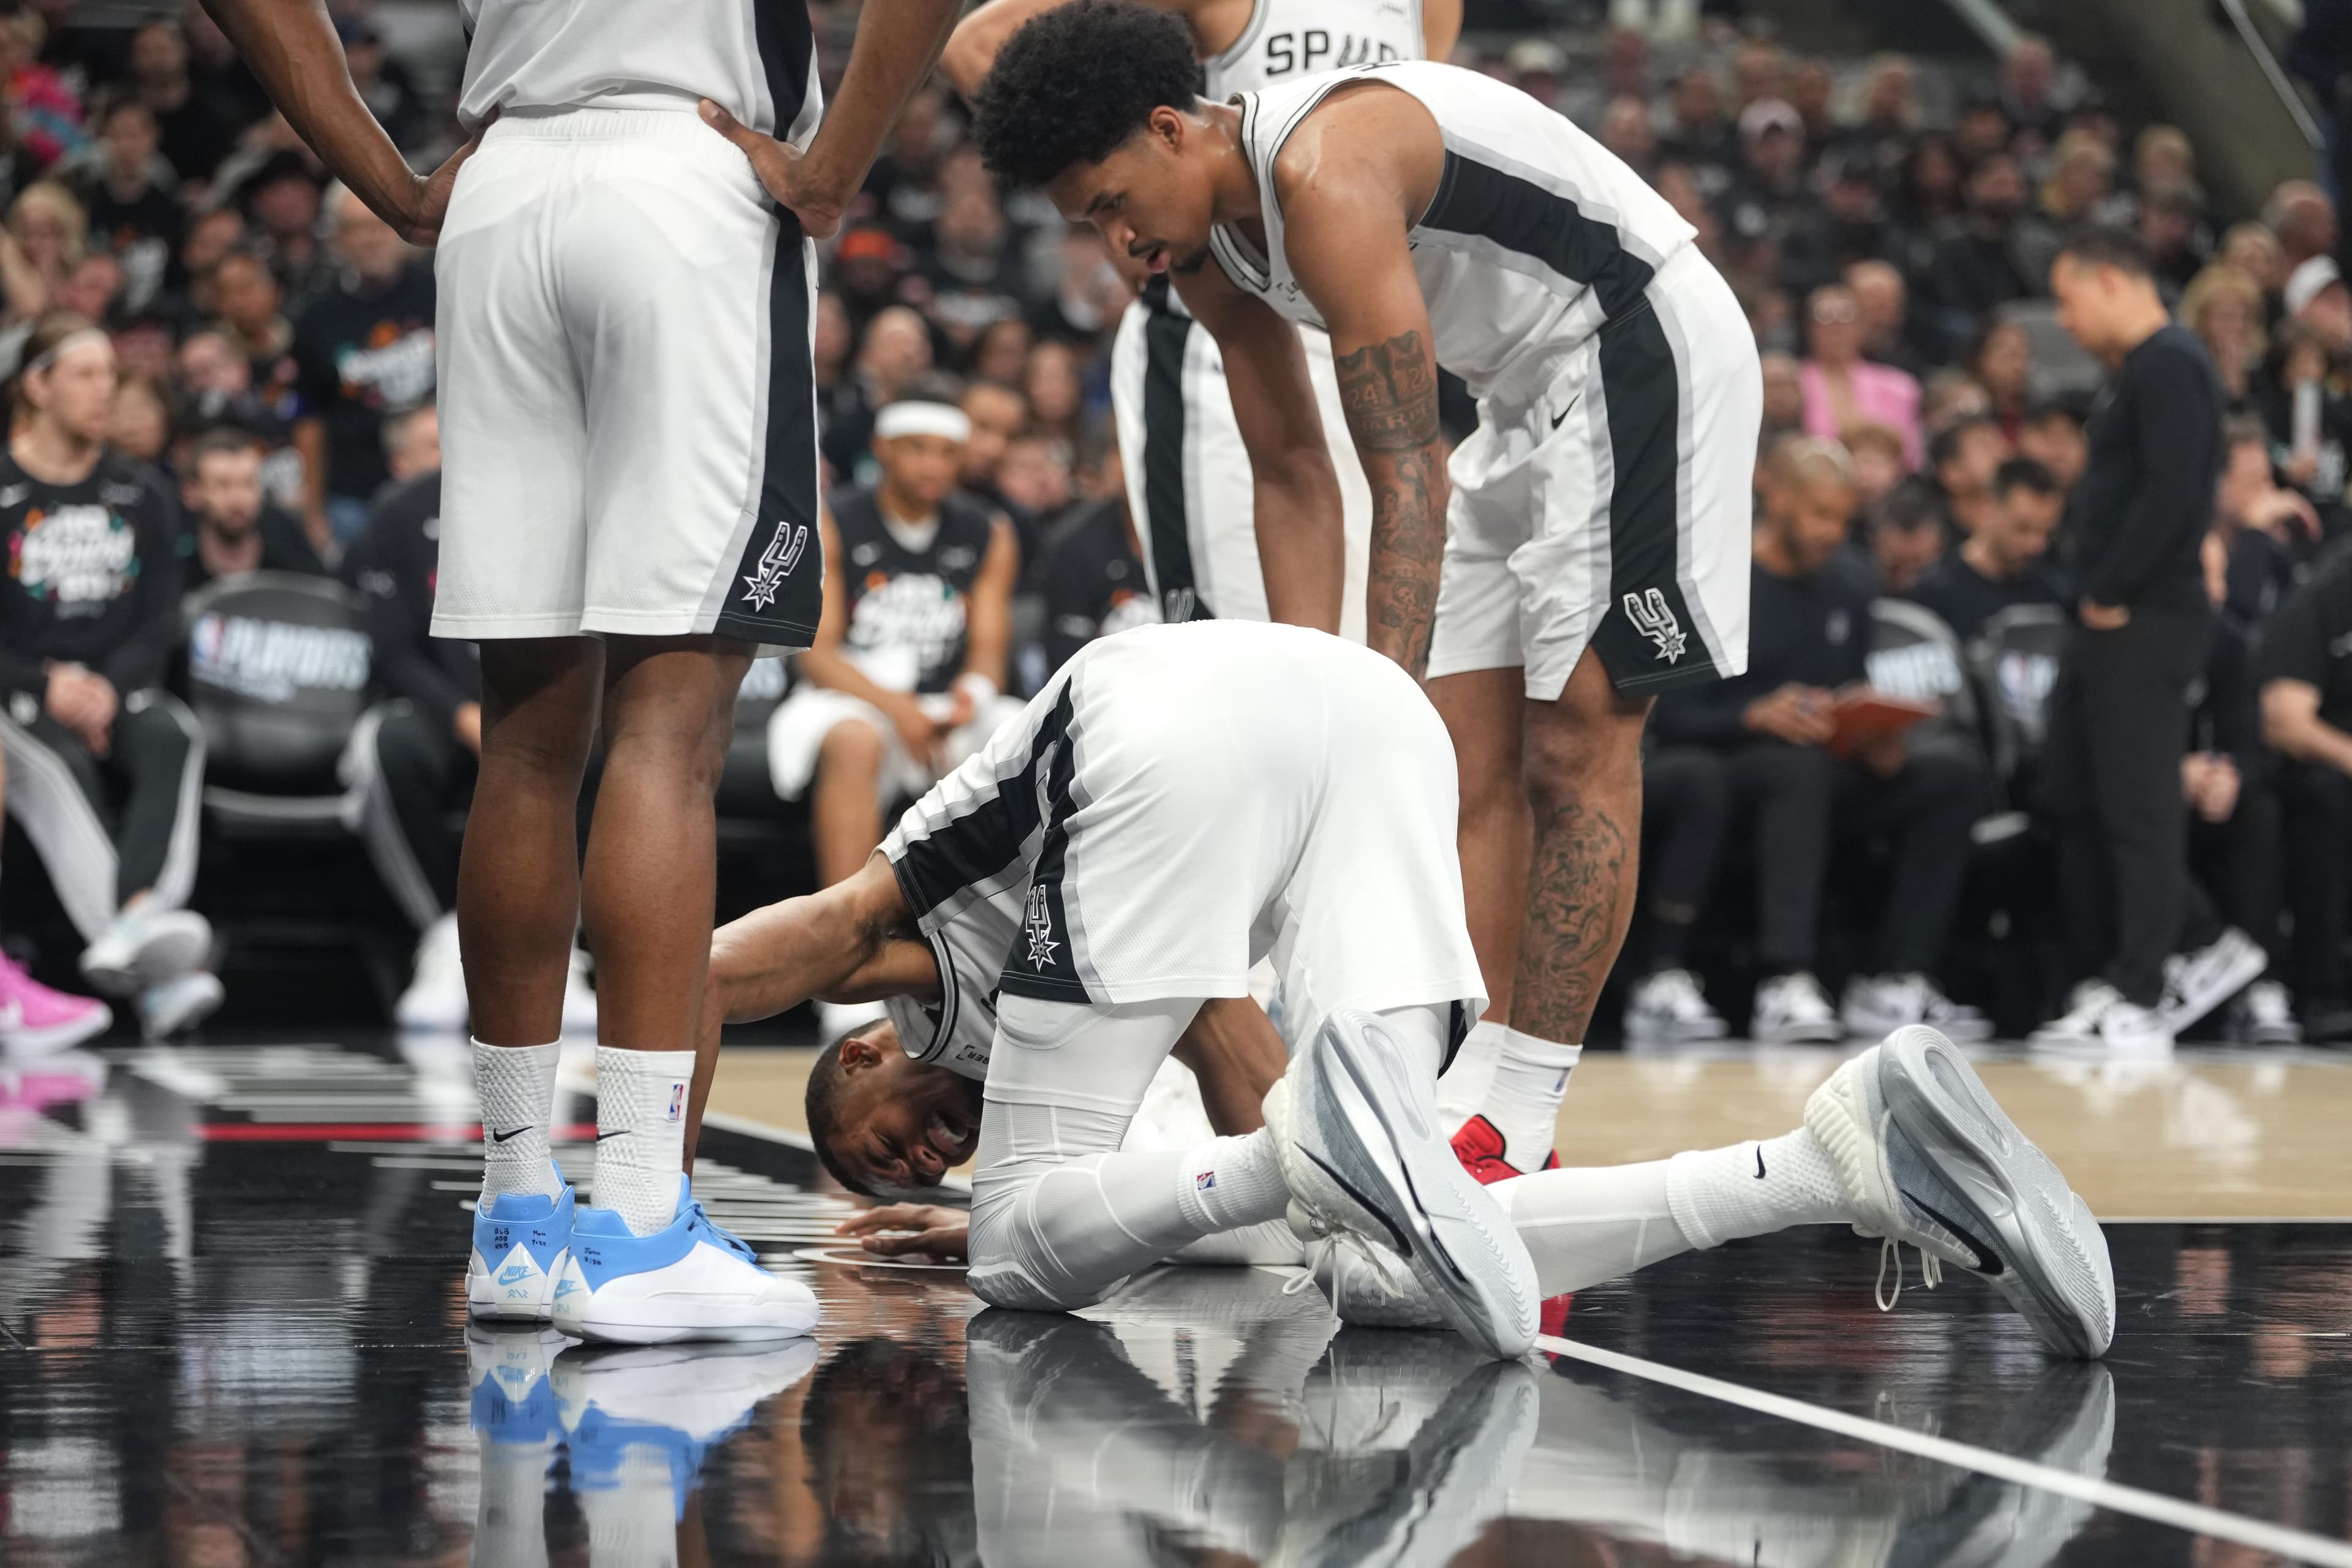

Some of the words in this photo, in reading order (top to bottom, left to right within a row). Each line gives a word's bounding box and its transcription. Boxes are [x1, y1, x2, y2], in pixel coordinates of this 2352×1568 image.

[1266, 31, 1408, 75] SPU
[967, 1051, 990, 1065] GER
[504, 1265, 530, 1277] NIKE
